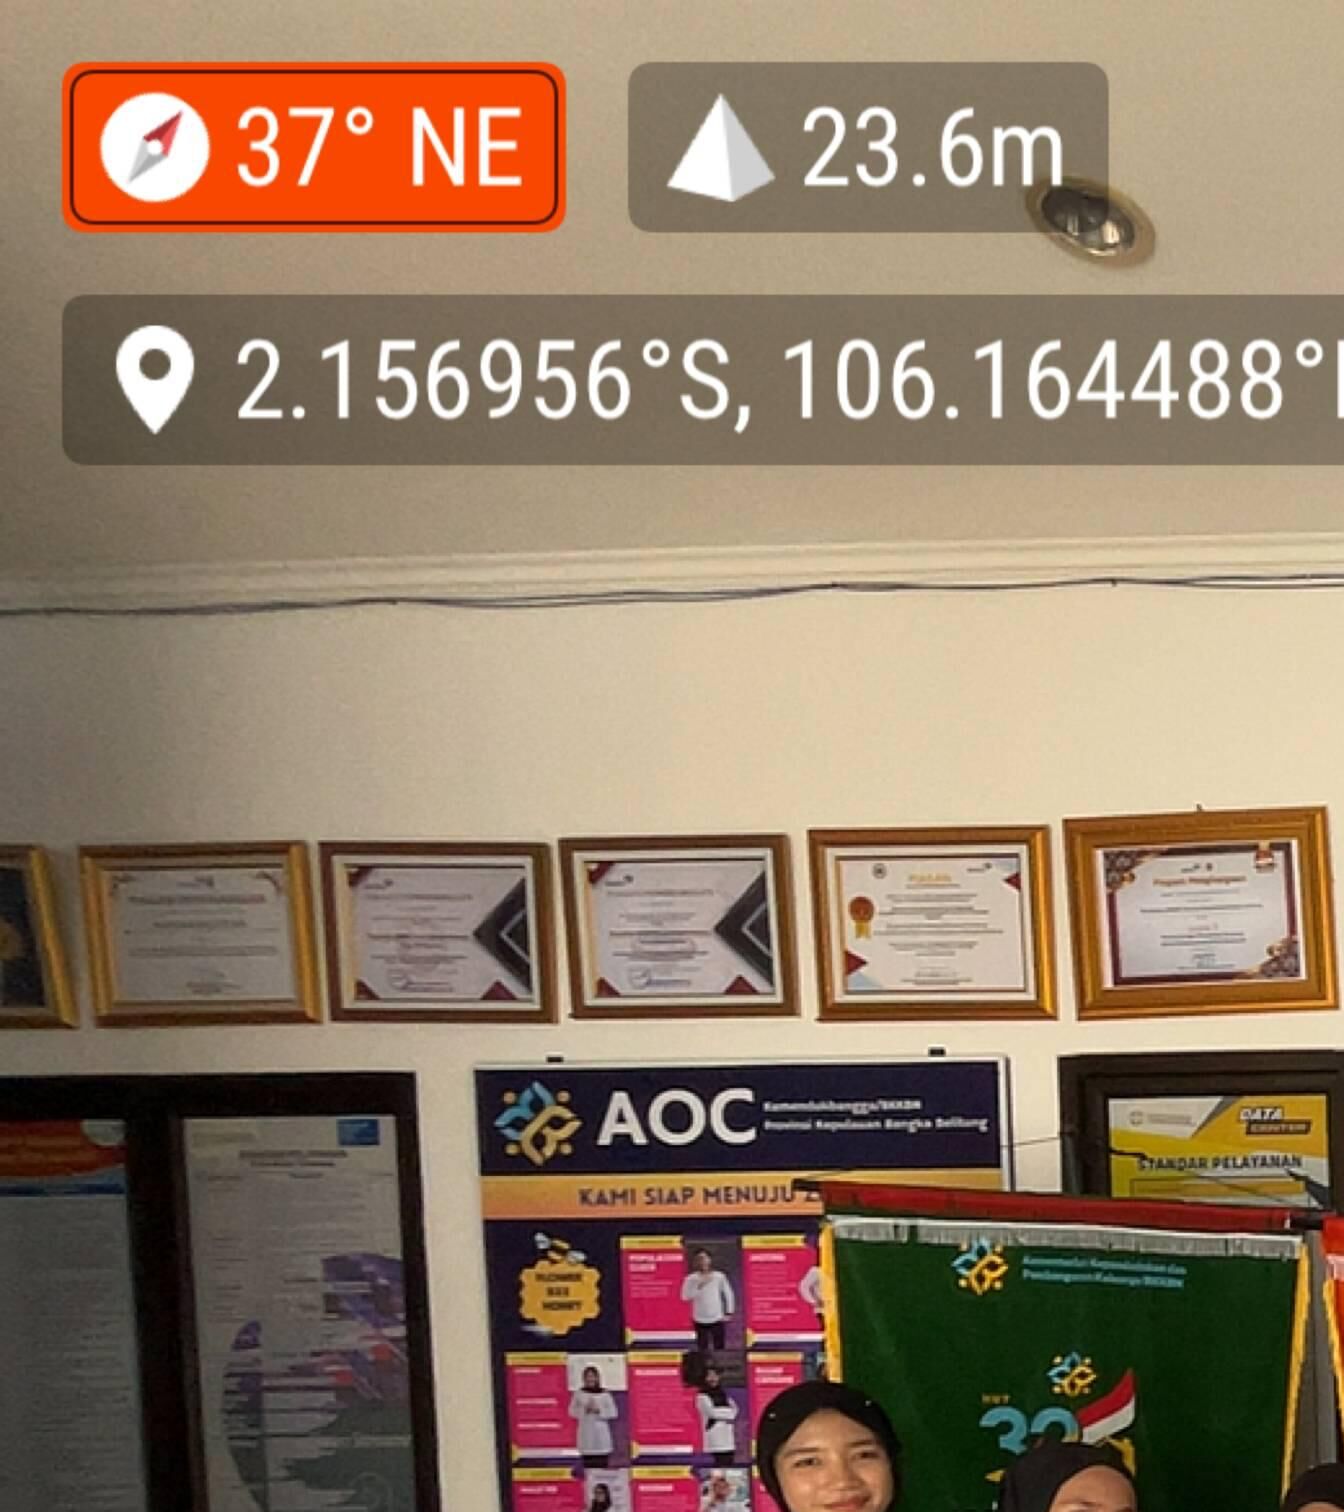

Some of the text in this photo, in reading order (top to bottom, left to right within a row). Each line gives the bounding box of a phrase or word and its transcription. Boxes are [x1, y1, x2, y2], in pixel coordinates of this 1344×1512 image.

[596, 1087, 757, 1147] AOC
[578, 1186, 637, 1206] KAMI
[644, 1186, 695, 1206] SIAP
[702, 1184, 796, 1206] MENUJU
